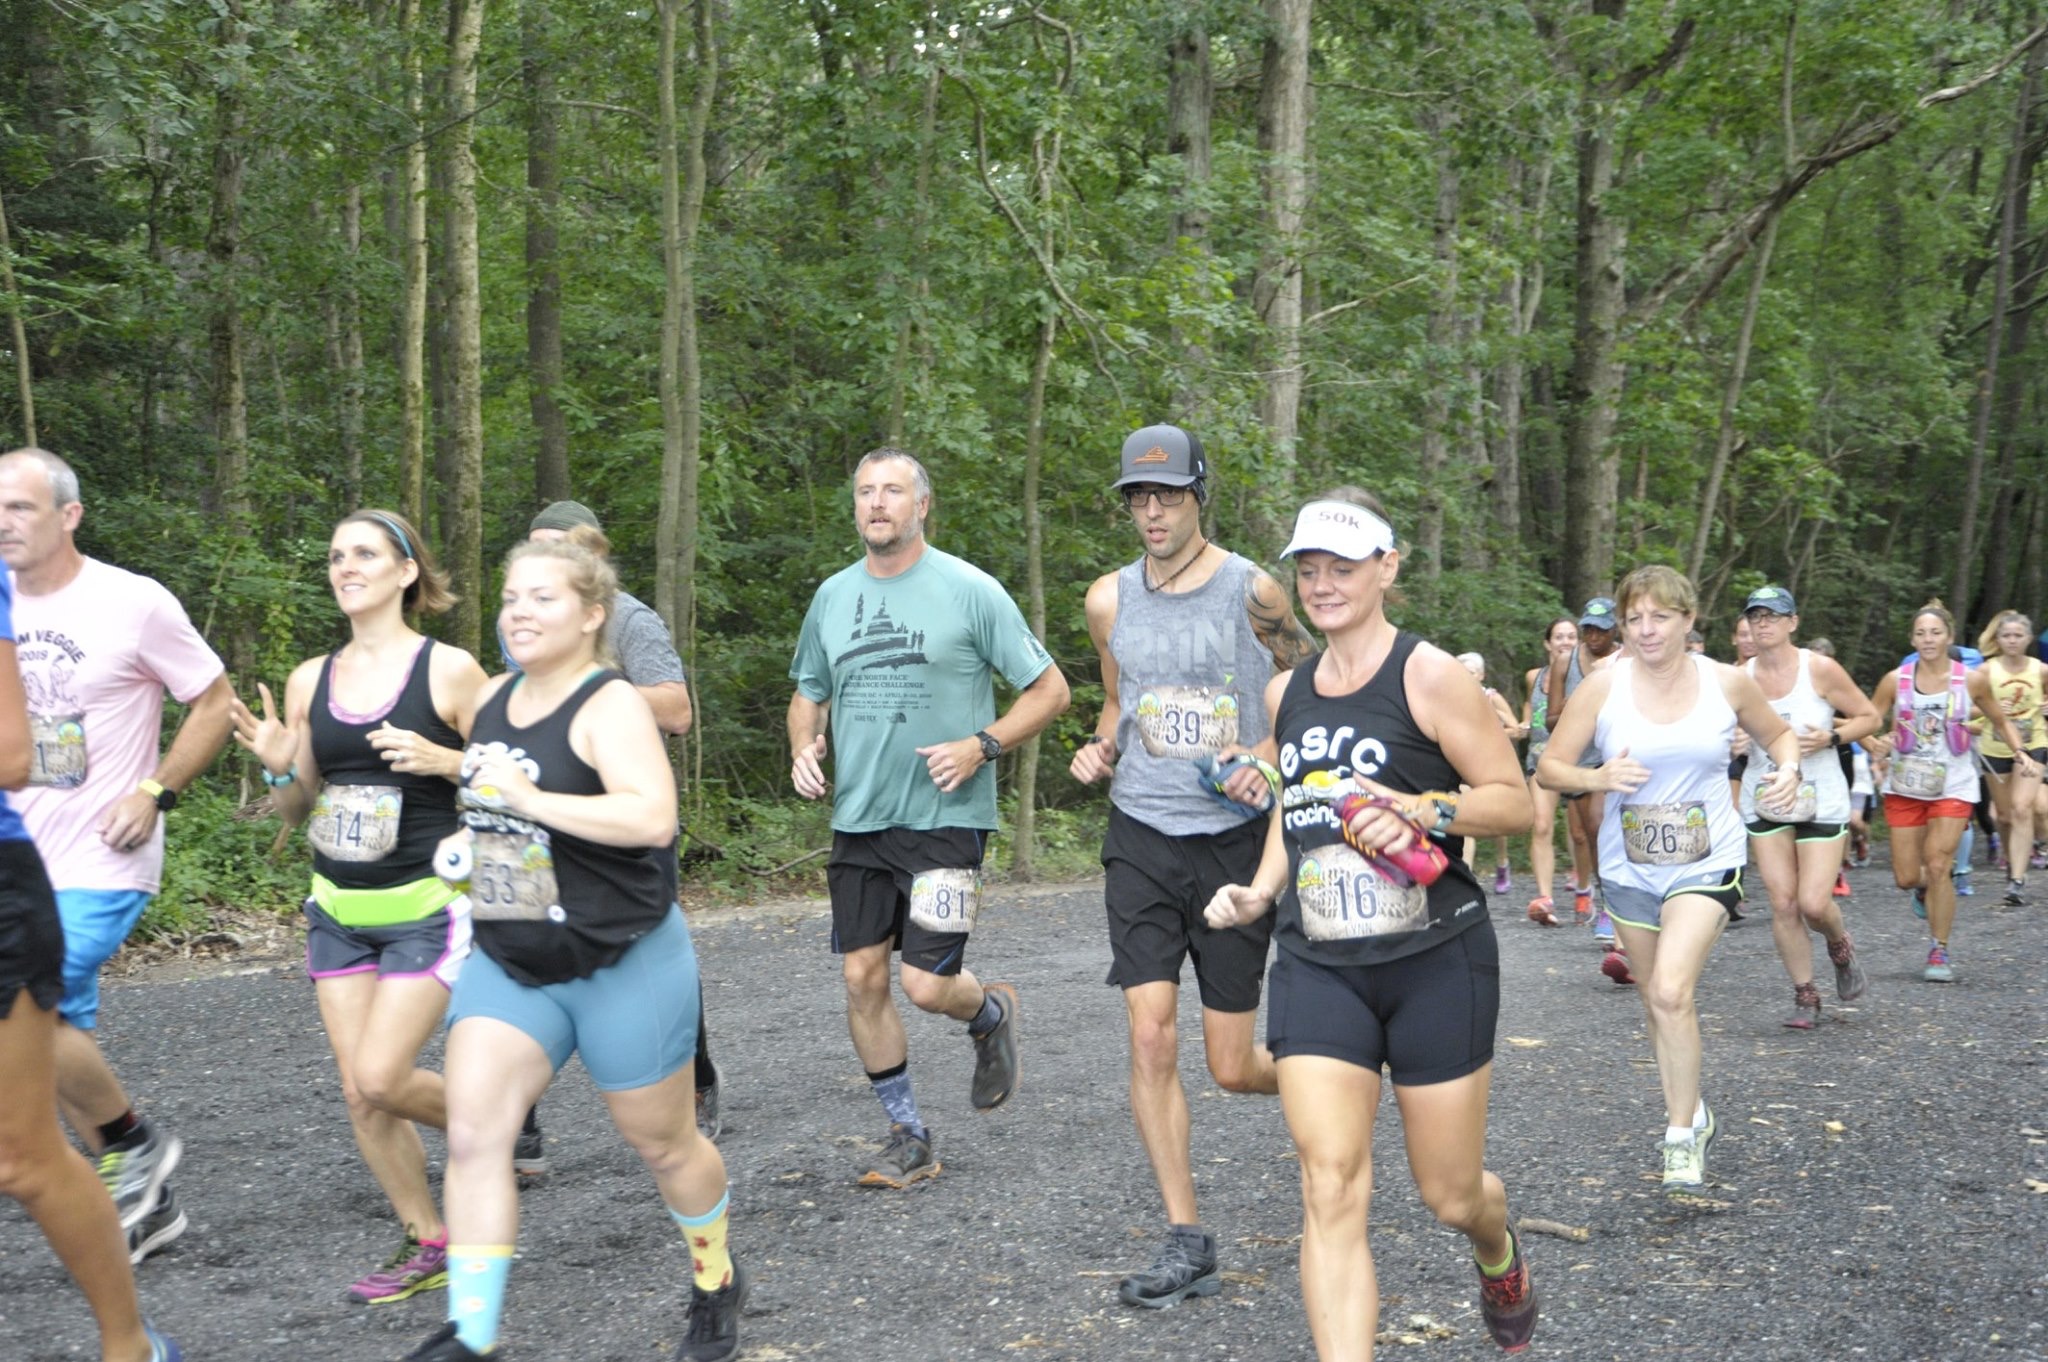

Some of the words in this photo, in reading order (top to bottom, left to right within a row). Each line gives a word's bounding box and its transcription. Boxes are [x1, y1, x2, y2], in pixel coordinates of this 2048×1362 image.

[35, 629, 86, 665] VEGGIE
[1165, 710, 1200, 745] 39
[35, 740, 46, 775] 1
[1280, 725, 1386, 778] esrc
[335, 810, 361, 847] 14
[1285, 802, 1341, 831] racing
[1644, 823, 1677, 855] 26
[480, 862, 517, 905] 53
[1334, 872, 1378, 921] 16
[936, 888, 965, 920] 81
